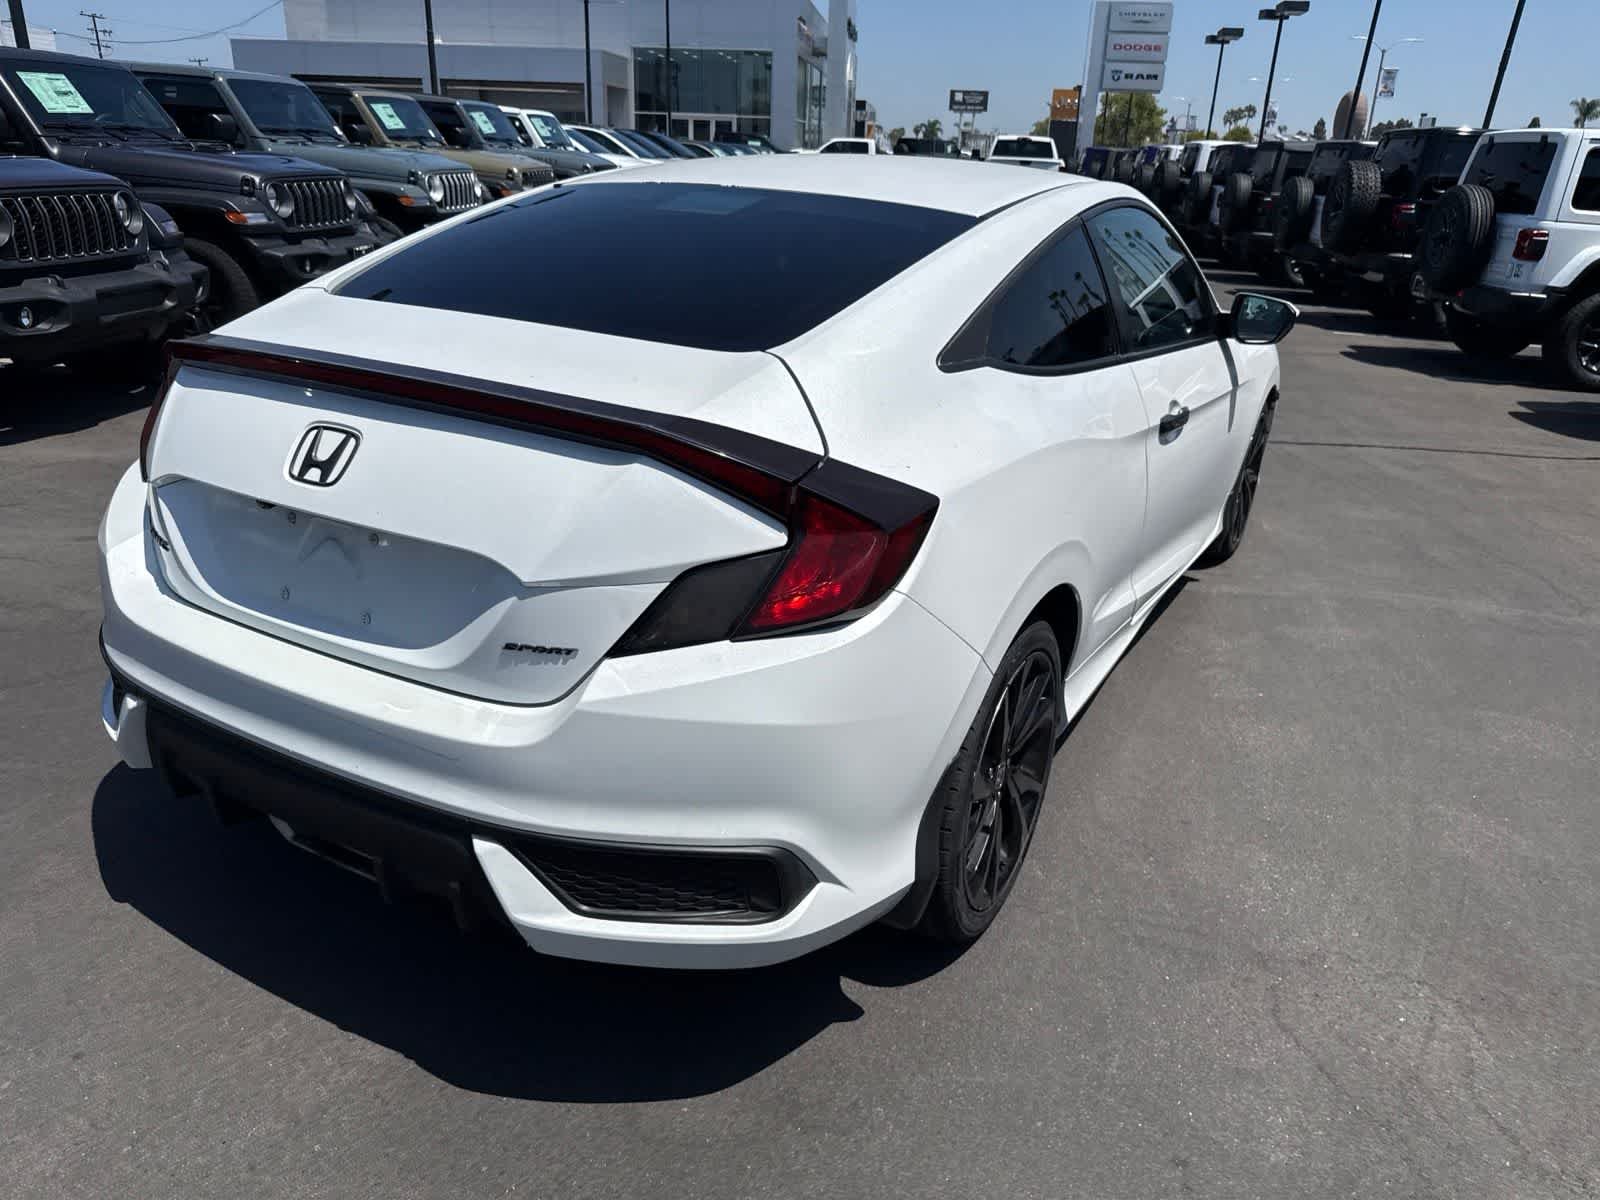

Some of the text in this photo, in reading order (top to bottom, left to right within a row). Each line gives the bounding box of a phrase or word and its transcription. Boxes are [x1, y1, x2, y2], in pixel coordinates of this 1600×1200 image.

[1113, 43, 1162, 52] DODGE
[1124, 73, 1159, 81] RAM
[502, 642, 579, 655] SPORT
